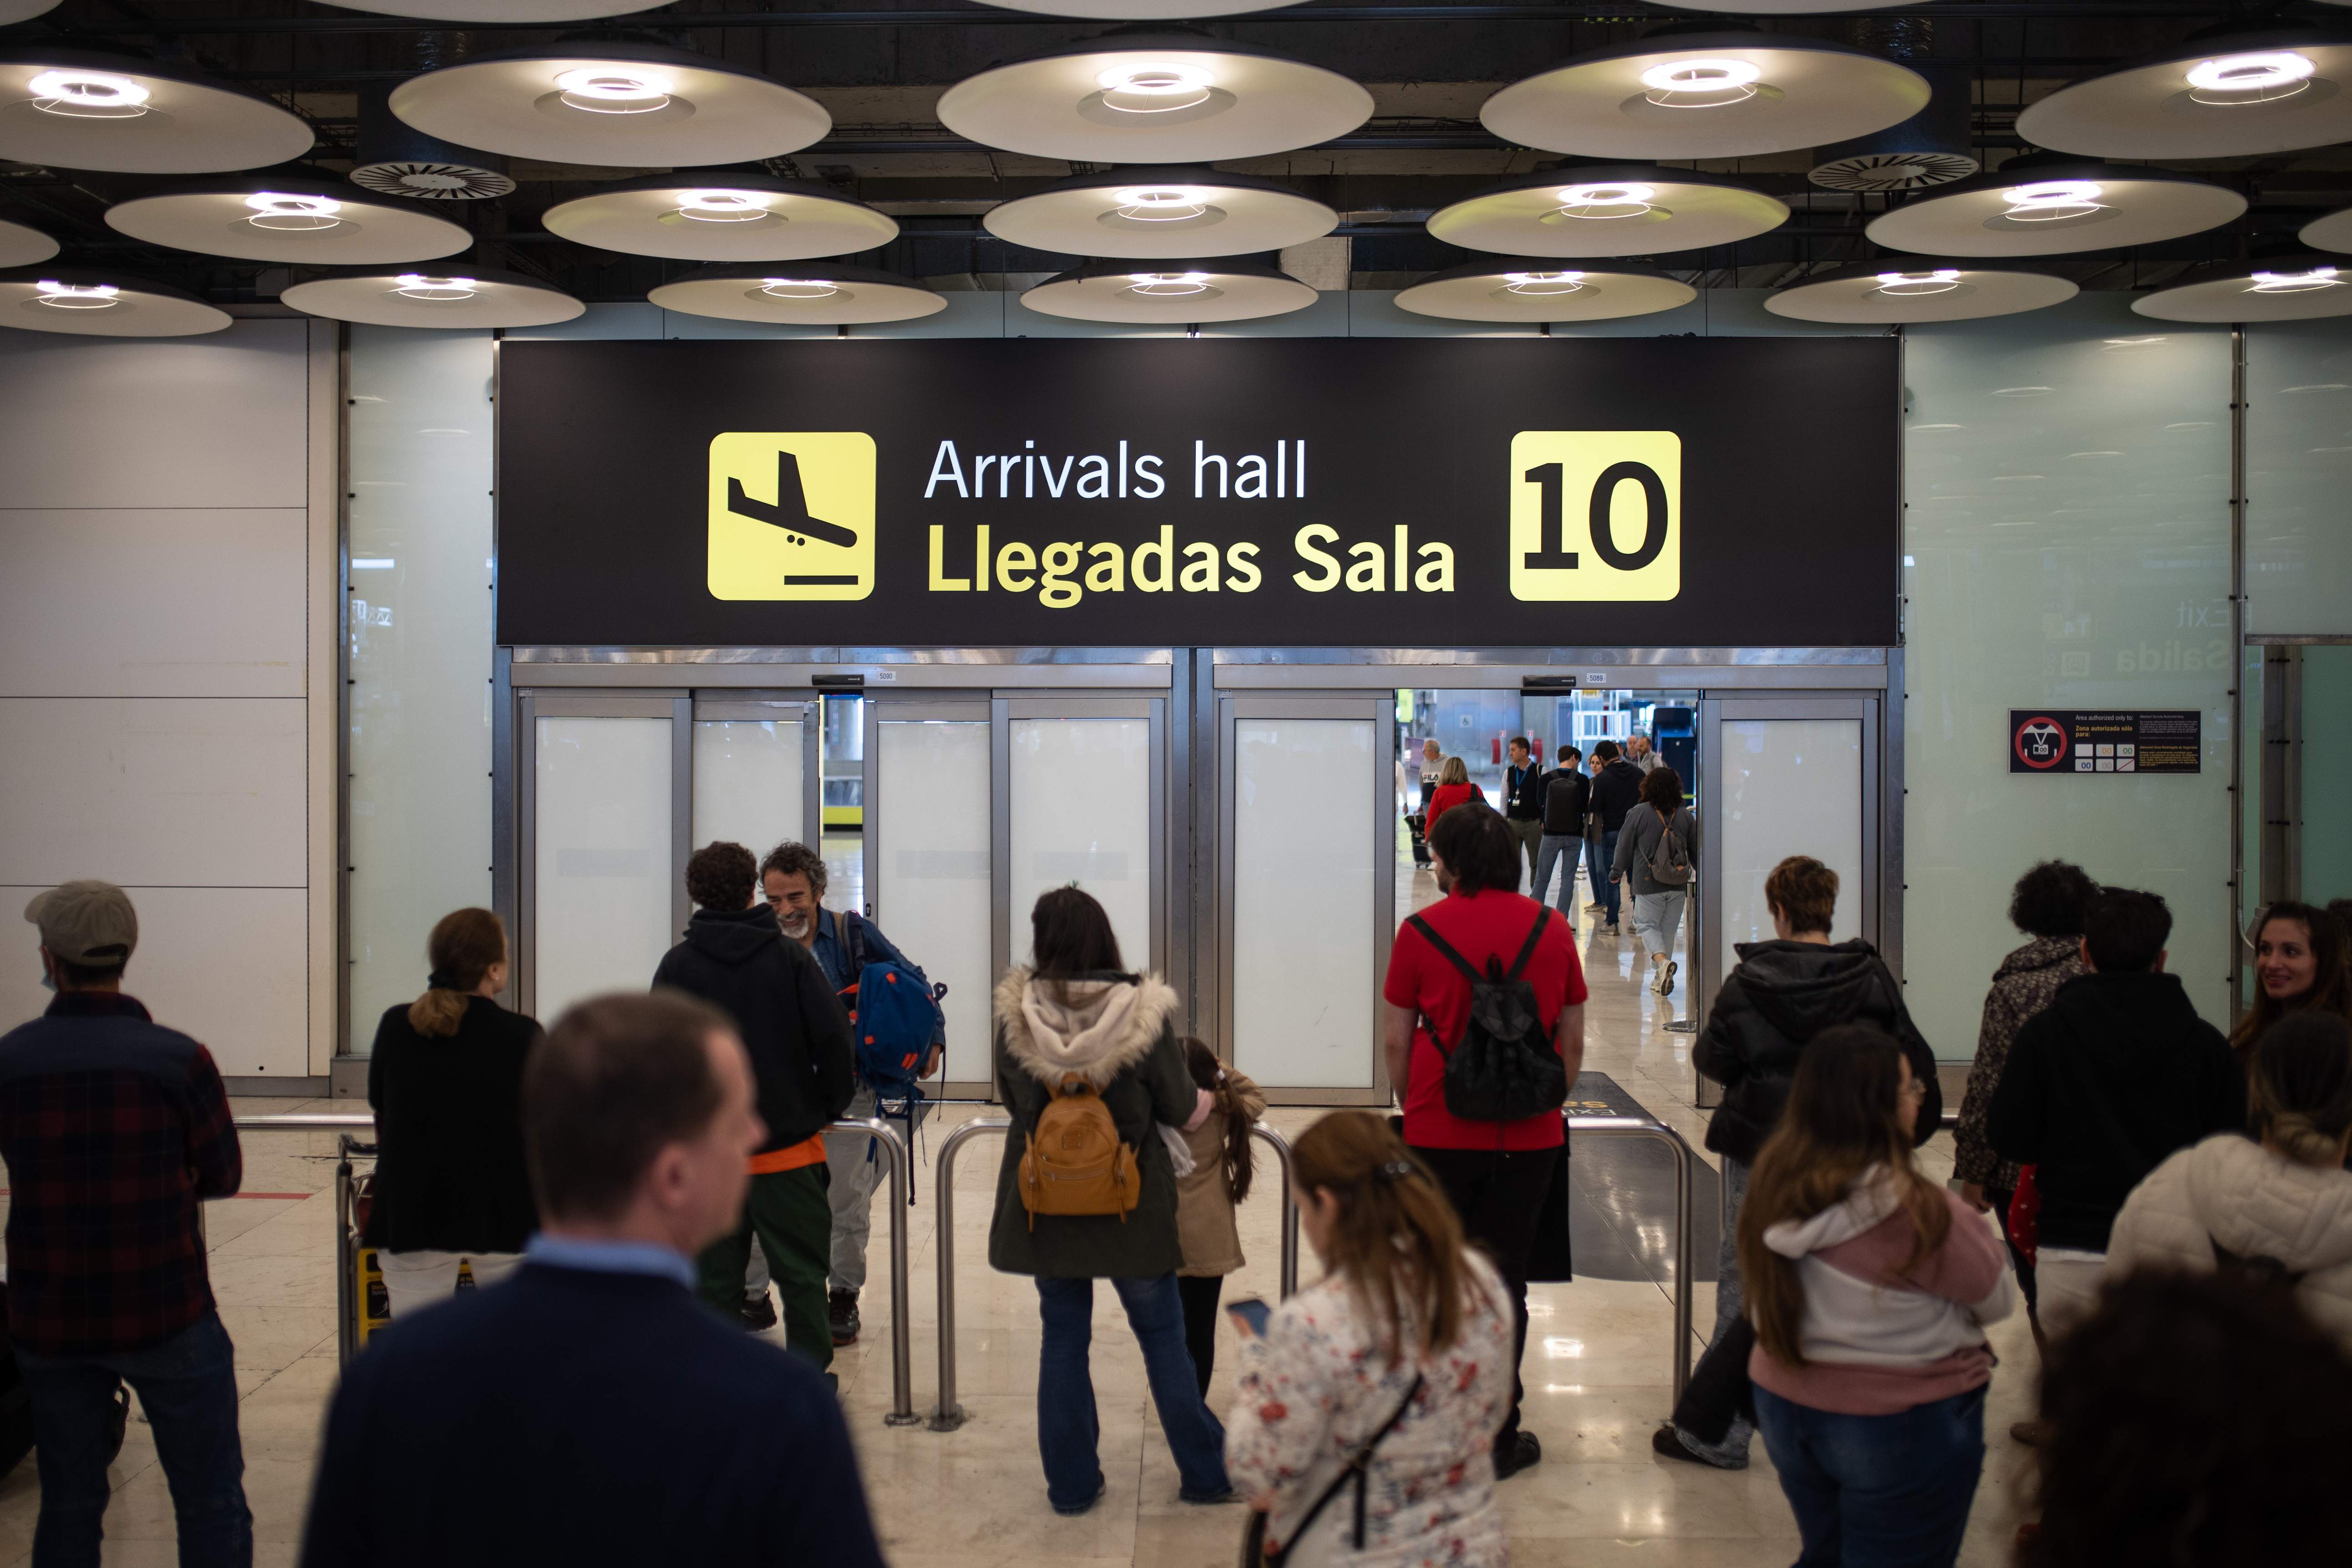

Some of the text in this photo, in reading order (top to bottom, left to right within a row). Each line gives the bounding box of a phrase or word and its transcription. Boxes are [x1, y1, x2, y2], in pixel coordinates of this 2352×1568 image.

[924, 440, 1305, 499] Arrivals hall
[1524, 461, 1668, 571] 10
[929, 523, 1455, 608] Llegadas Sala
